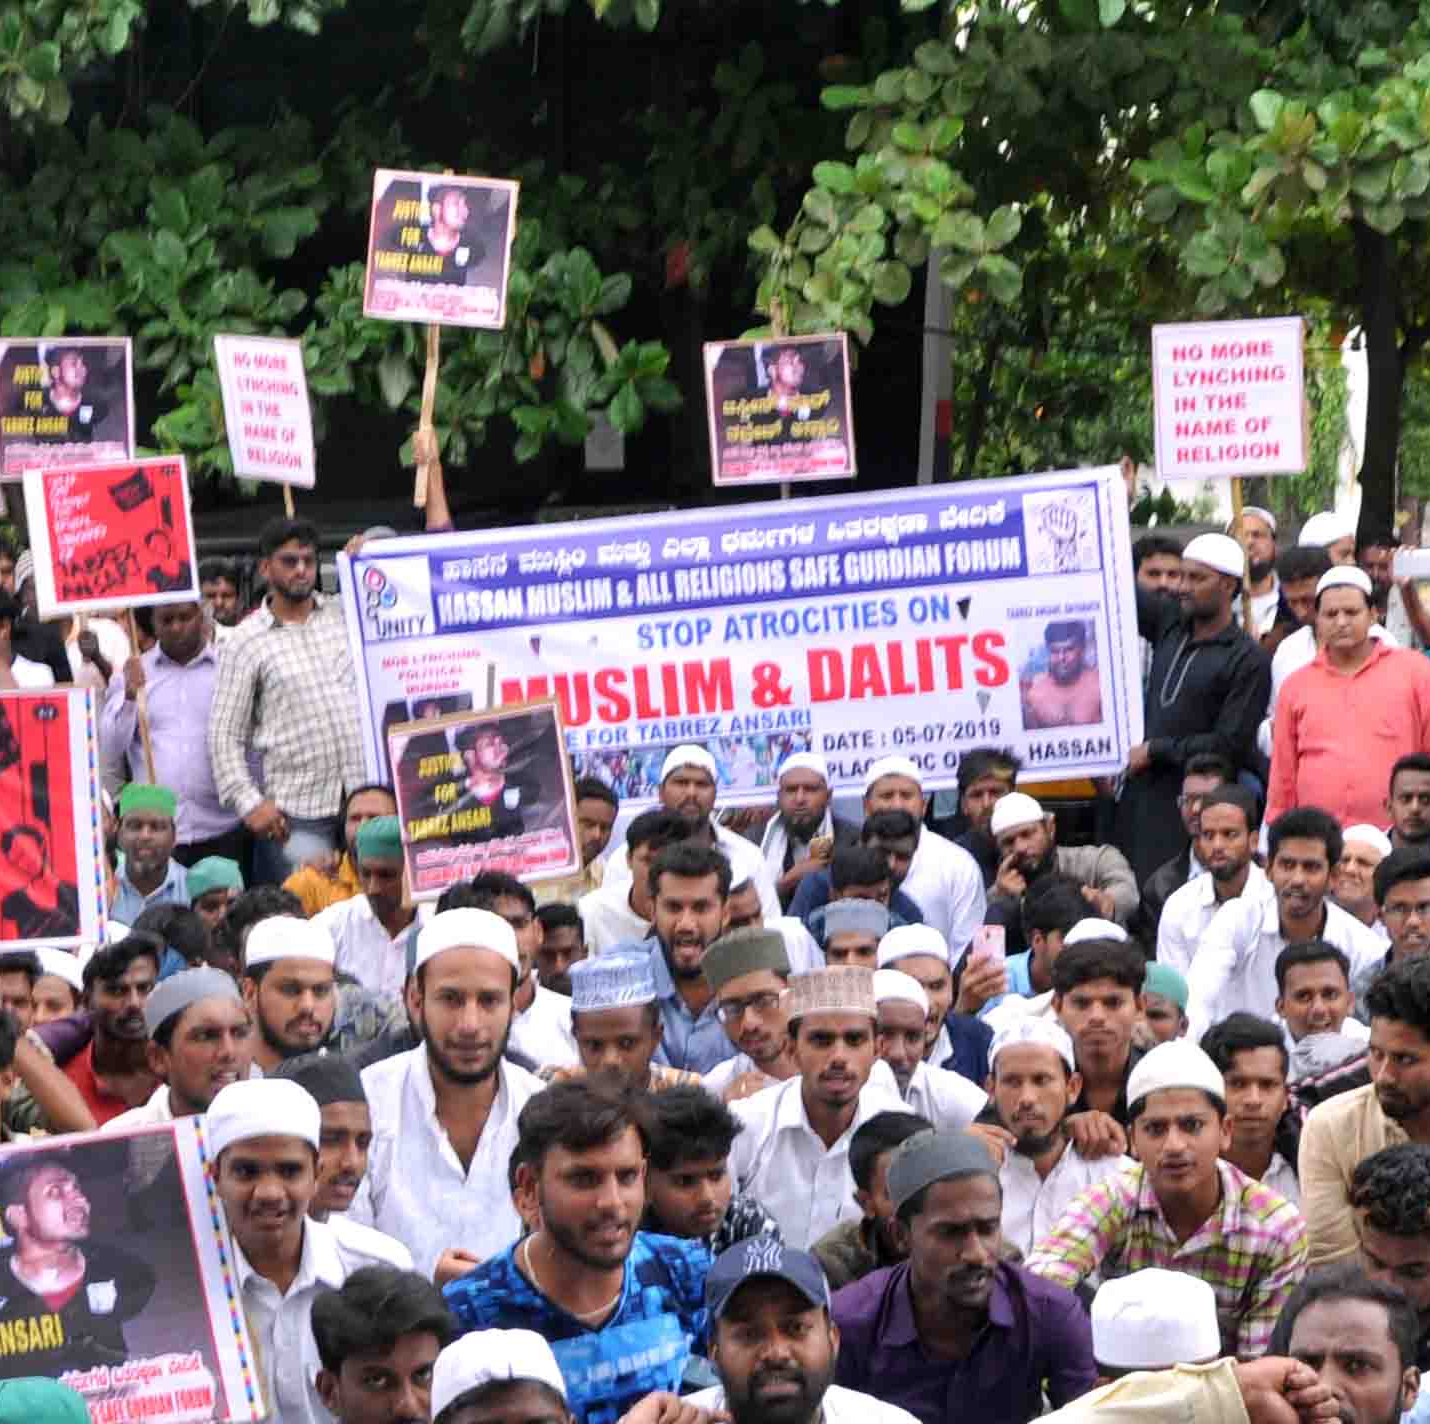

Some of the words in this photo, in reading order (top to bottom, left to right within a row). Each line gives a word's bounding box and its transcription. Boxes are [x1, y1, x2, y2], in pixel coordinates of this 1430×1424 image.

[1173, 344, 1203, 362] NO
[1211, 340, 1274, 359] MORE
[1173, 365, 1286, 387] LYNCHING
[1175, 397, 1195, 413] IN
[1205, 392, 1246, 411] THE
[1176, 419, 1235, 437] NAME
[1244, 416, 1273, 433] OF
[1177, 440, 1280, 464] RELIGION
[437, 587, 523, 626] HASSAN
[526, 577, 612, 617] MUSLIM
[616, 579, 633, 608] &
[636, 571, 672, 607] ALL
[675, 557, 786, 603] RELIGIONS
[789, 553, 842, 591] SAFE
[844, 545, 941, 583] GURDIAN
[945, 537, 1021, 573] FORUM
[379, 615, 427, 637] UNITY
[637, 617, 712, 651] STOP
[723, 600, 898, 643] ATROCITIES
[908, 595, 950, 624] ON
[751, 661, 793, 709] &
[806, 629, 1011, 704] DALITS
[586, 727, 630, 746] FOR
[638, 718, 721, 742] TABREZ
[729, 709, 812, 735] ANSARI
[823, 730, 876, 752] DATE
[892, 718, 1002, 746] 05-07-2019
[1028, 737, 1112, 762] HASSAN
